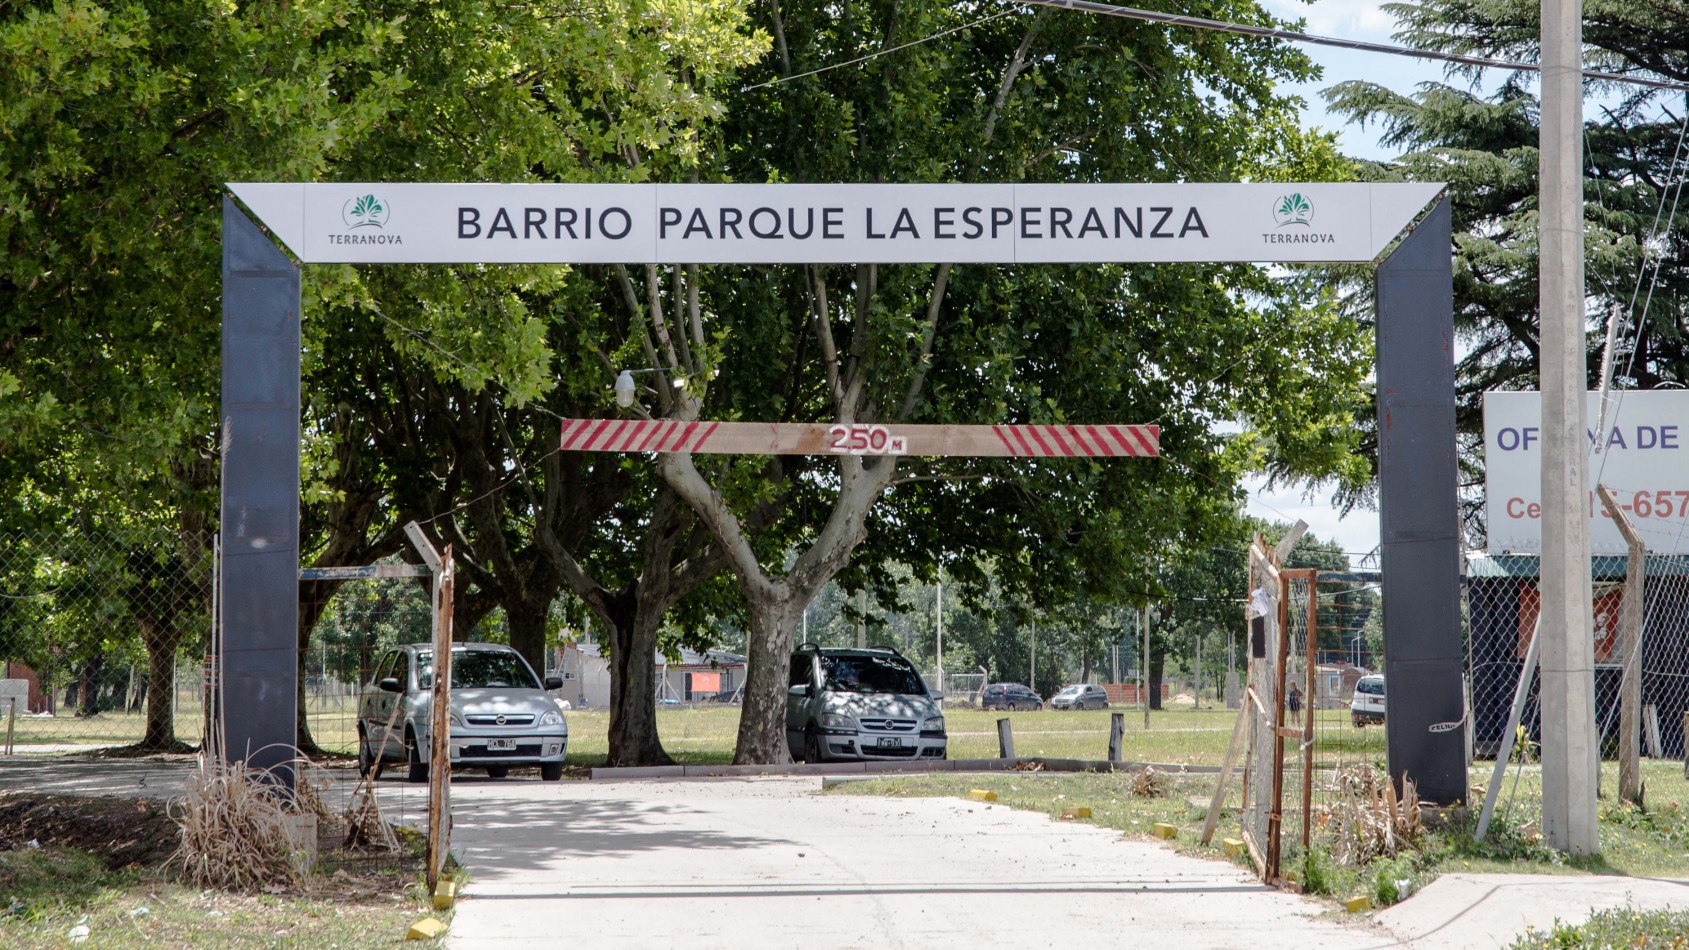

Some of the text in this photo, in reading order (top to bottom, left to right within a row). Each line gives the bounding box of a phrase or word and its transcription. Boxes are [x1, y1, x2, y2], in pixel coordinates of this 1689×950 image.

[458, 206, 1210, 240] BARRIO PARQUE LA ESPERANZA
[328, 234, 403, 245] TERRANOVA
[1262, 233, 1336, 244] TERRANOVA
[1637, 425, 1680, 450] DE
[1506, 497, 1542, 519] Ce
